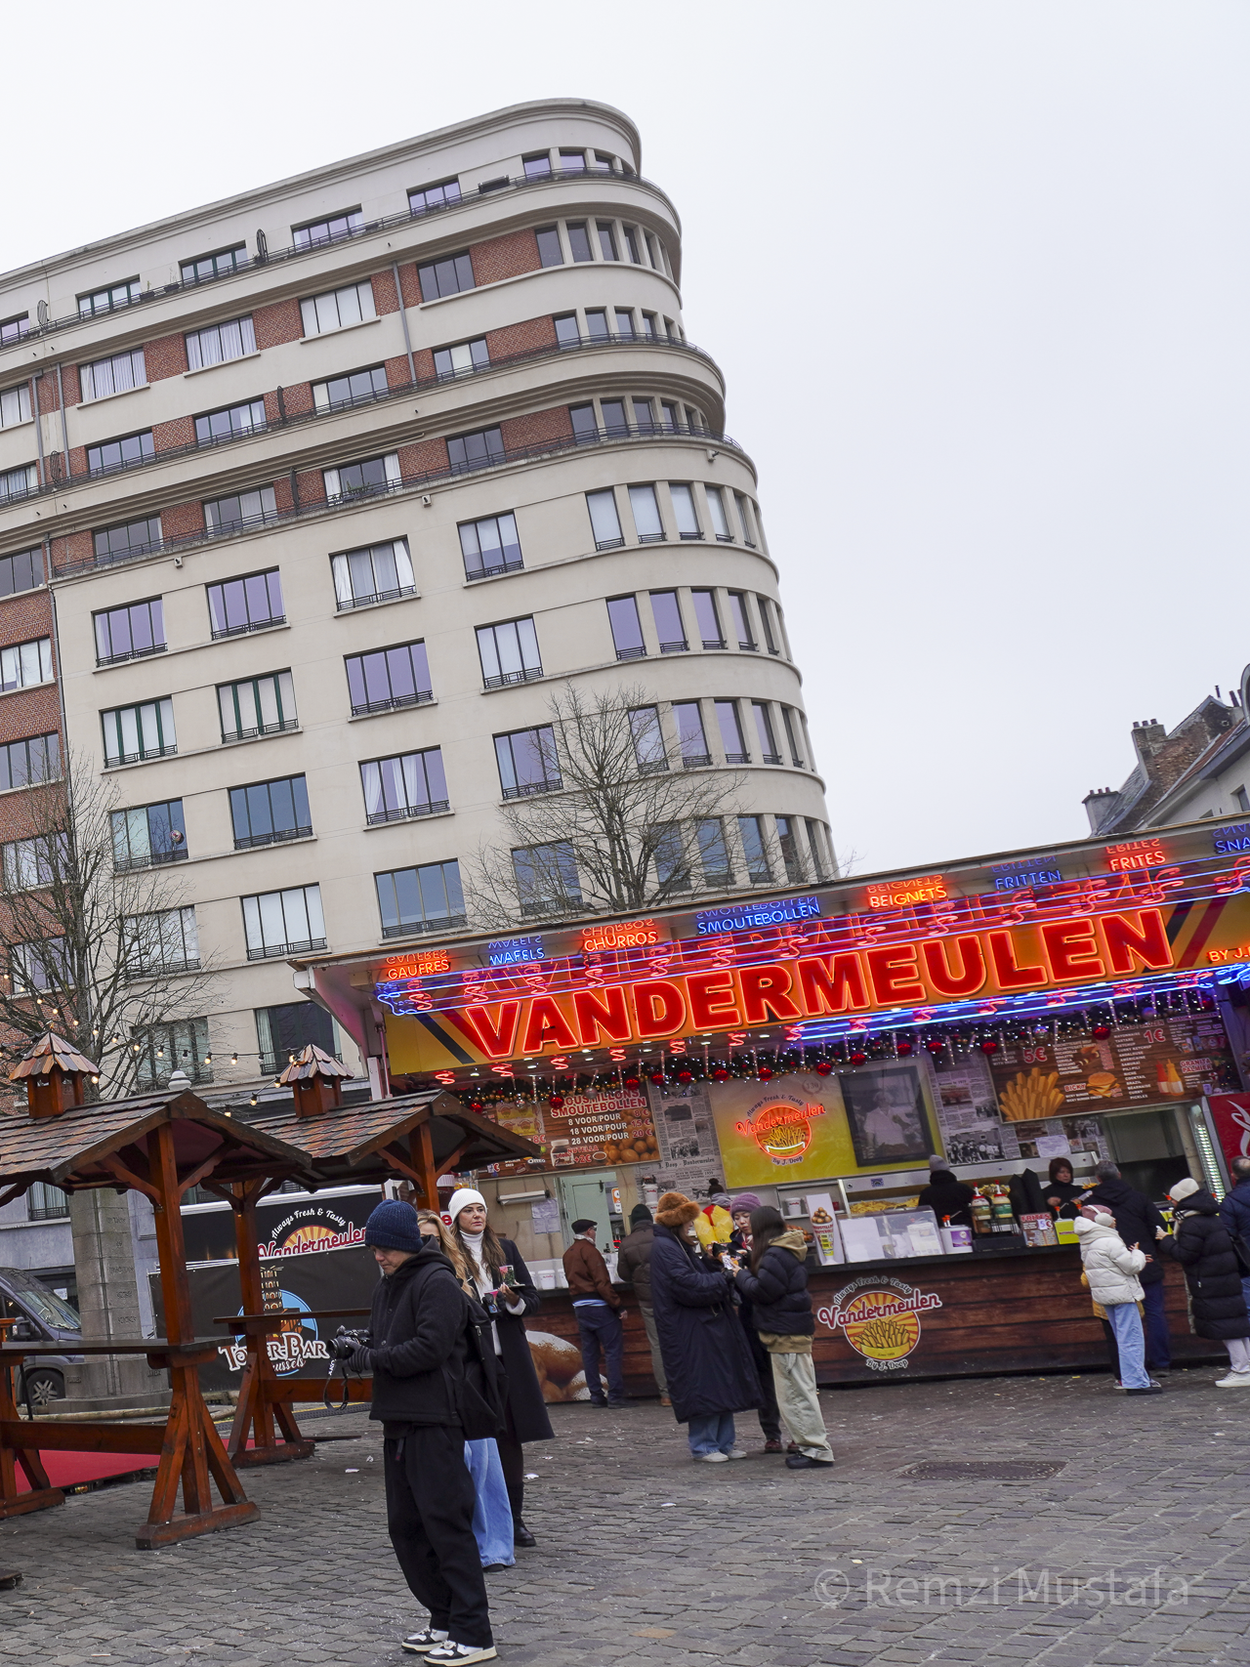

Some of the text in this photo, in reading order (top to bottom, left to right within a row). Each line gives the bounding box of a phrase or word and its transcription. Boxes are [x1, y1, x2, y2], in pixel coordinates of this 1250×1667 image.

[1110, 850, 1166, 872] FRITES
[995, 869, 1062, 891] FRITTEN
[869, 885, 948, 909] BEIGNETS
[697, 902, 822, 935] SMOUTEBOLLEN
[583, 930, 658, 953] CHURROS
[489, 947, 545, 966] WAFELS
[1208, 946, 1250, 962] BY J.
[387, 958, 450, 981] GAUFRES
[465, 907, 1175, 1060] VANDERMEULEN
[1143, 1028, 1166, 1044] 1€
[1023, 1046, 1048, 1063] 5€
[551, 1097, 647, 1118] SMOUTEBOLLEN
[567, 1118, 574, 1126] 8
[630, 1119, 643, 1127] 15
[735, 1102, 827, 1137] Vandermeulen
[632, 1129, 644, 1138] 20
[271, 1207, 347, 1240] Always Fresh & Tasty
[817, 1288, 942, 1330] Vandermeulen
